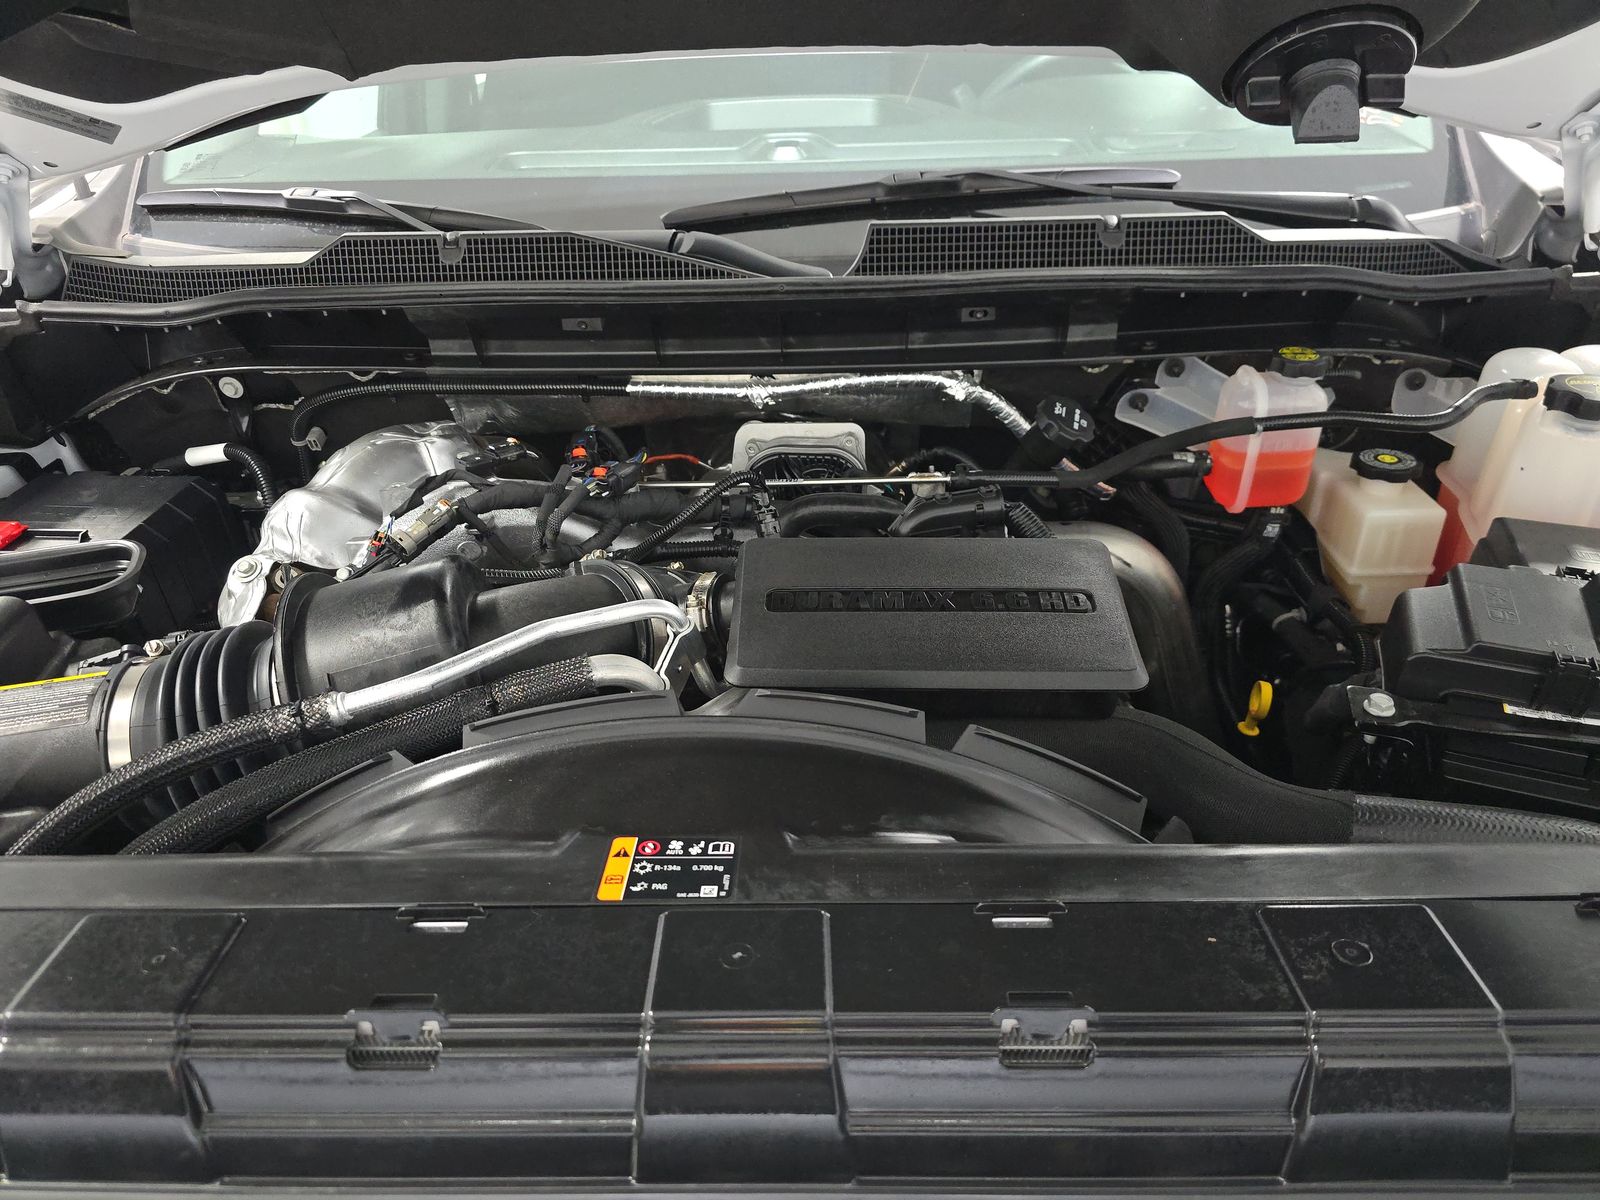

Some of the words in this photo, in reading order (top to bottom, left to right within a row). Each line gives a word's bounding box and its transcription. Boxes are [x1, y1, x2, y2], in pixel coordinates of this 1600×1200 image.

[771, 591, 957, 610] DURAMAX
[970, 591, 1031, 610] 6.6
[1039, 591, 1093, 611] HD
